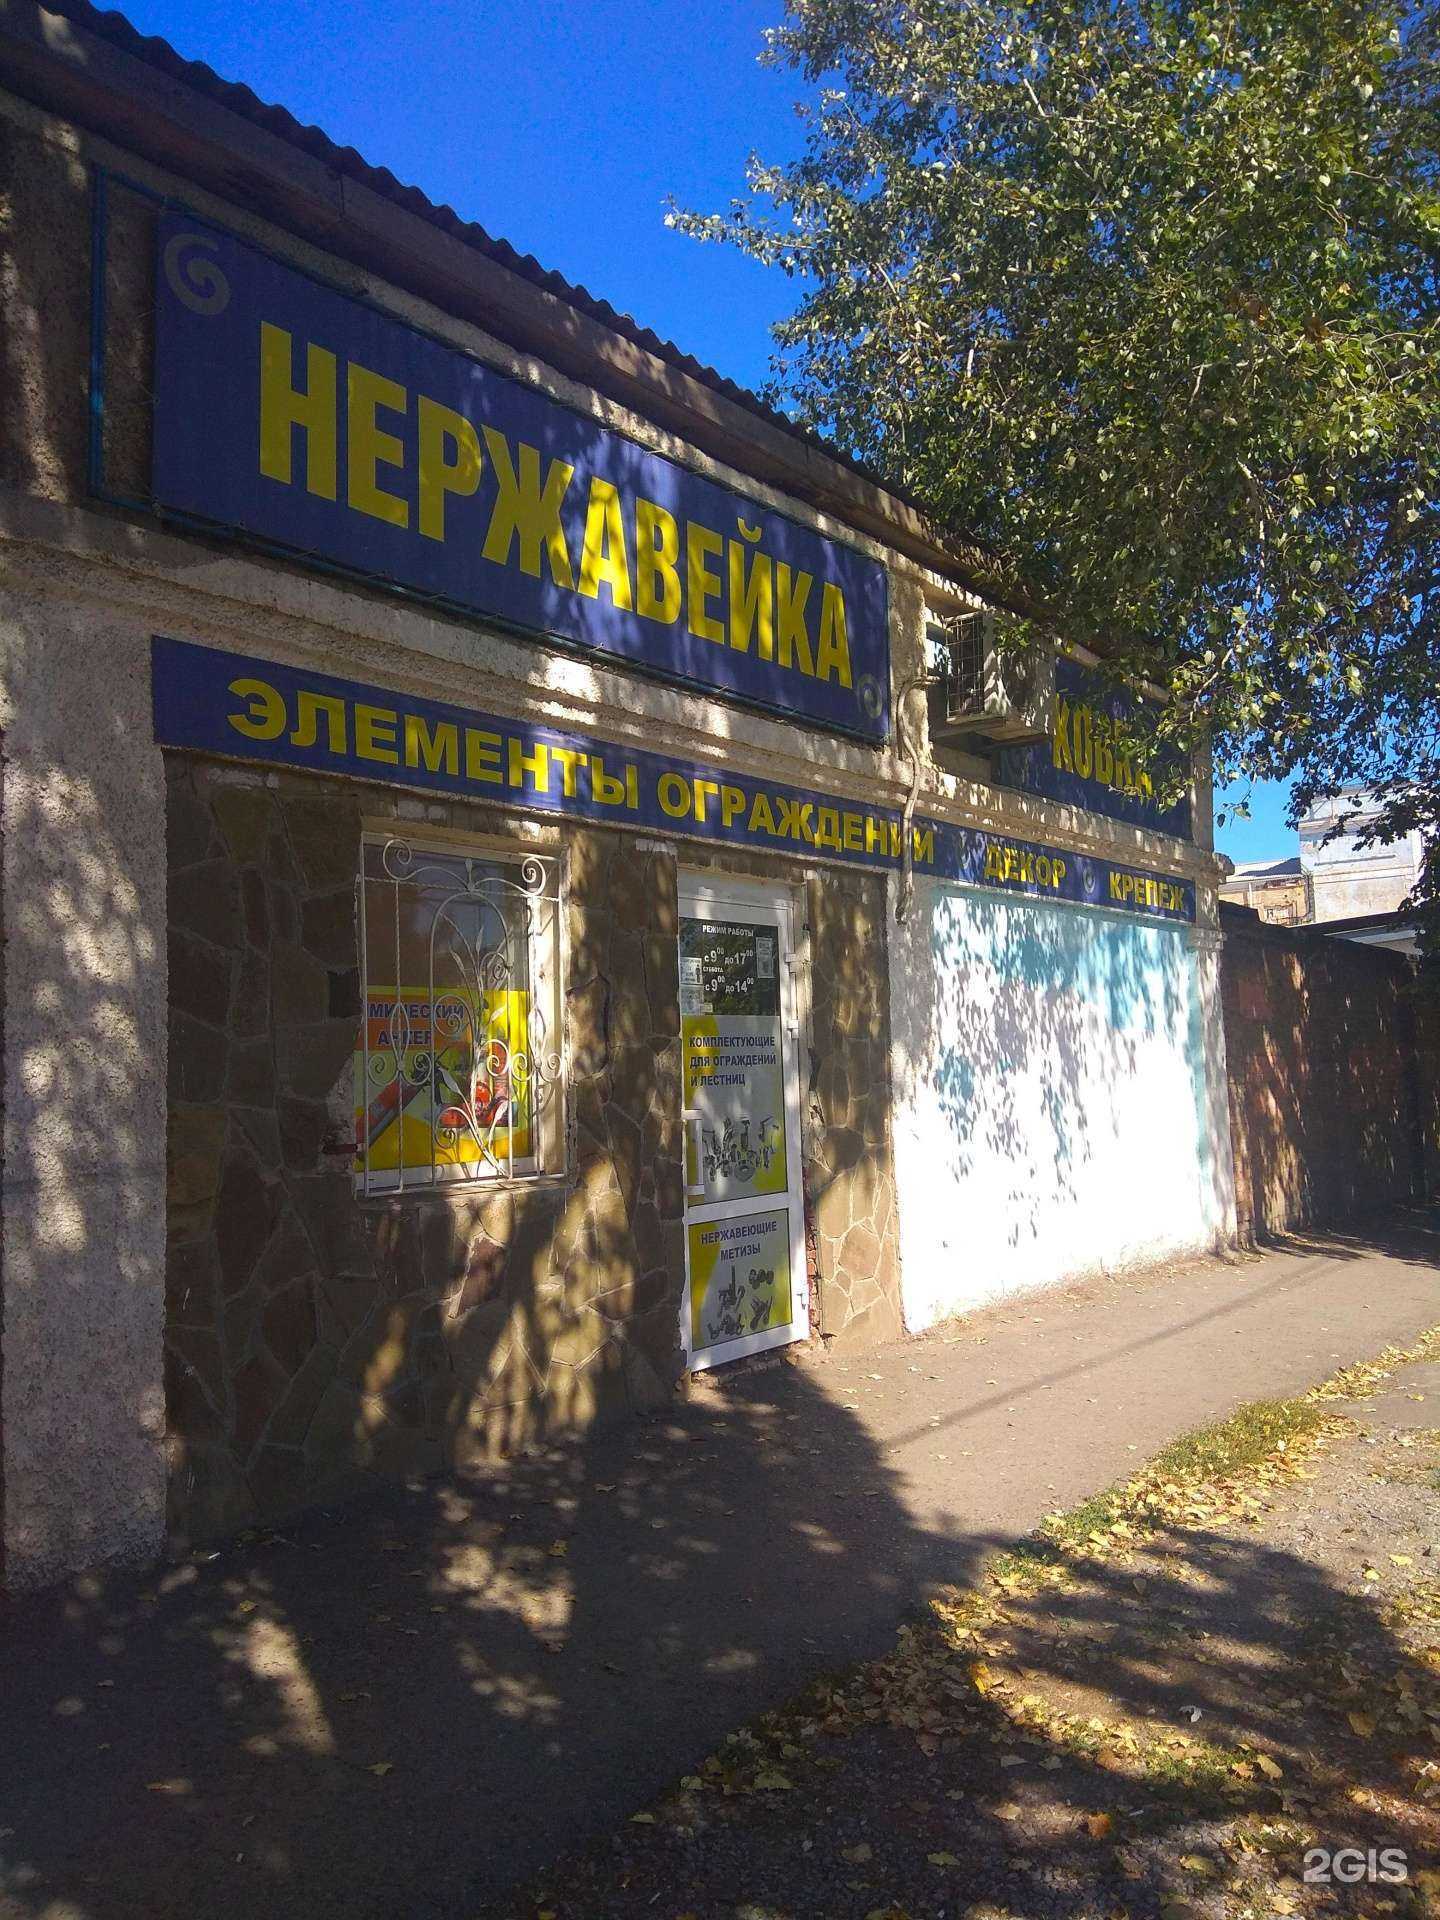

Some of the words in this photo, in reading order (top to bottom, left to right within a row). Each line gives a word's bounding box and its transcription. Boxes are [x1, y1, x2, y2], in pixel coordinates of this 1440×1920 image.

[259, 321, 853, 690] НЕРЖАВЕЙКА
[227, 678, 639, 810] ЭЛЕМЕНТЫ
[984, 843, 1067, 889] ДЕКОР
[1108, 871, 1185, 913] КРЕПЕЖ
[702, 924, 727, 934] РЕЖИМ
[728, 927, 754, 937] РАБОТЫ
[688, 1036, 776, 1048] КОМПЛЕКТУЮЩИЕ
[689, 1055, 710, 1070] ДЛЯ
[713, 1053, 777, 1067] ОГРАЖДЕНИЙ
[690, 1076, 698, 1087] И
[700, 1073, 746, 1087] ЛЕСТНИЦ
[701, 1221, 777, 1244] НЕРЖАВЕЮЩИЕ
[720, 1243, 760, 1260] МЕТИЗЫ
